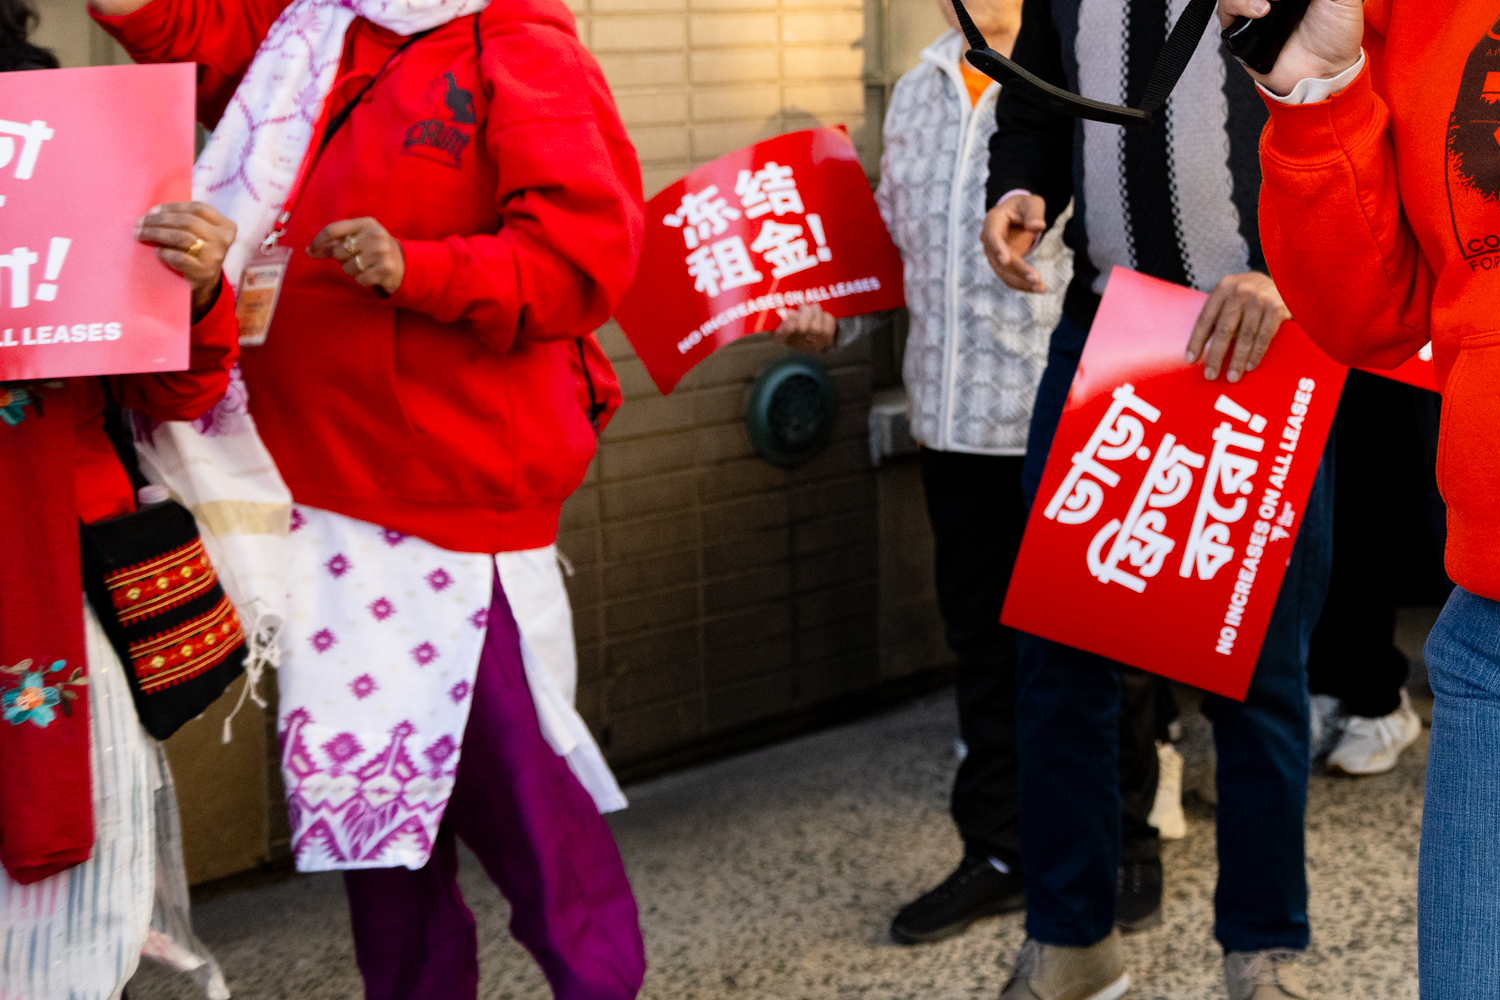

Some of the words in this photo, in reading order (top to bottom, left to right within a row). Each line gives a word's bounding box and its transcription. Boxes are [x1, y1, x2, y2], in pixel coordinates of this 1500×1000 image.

[1486, 48, 1492, 56] A
[662, 161, 805, 249] 冻结
[1469, 256, 1500, 272] FOR
[23, 322, 122, 346] LEASES
[677, 329, 702, 355] NO
[700, 292, 784, 337] INCREASES
[784, 290, 804, 306] ON
[805, 284, 831, 305] ALL
[829, 276, 882, 298] LEASES
[1279, 376, 1316, 452] LEASES
[1043, 383, 1161, 525] ভাড়া
[1268, 453, 1293, 490] ALL
[1086, 433, 1206, 593] ফ্রিজ
[1258, 488, 1281, 520] ON
[1224, 519, 1271, 627] INCREASES
[1215, 626, 1238, 656] NO
